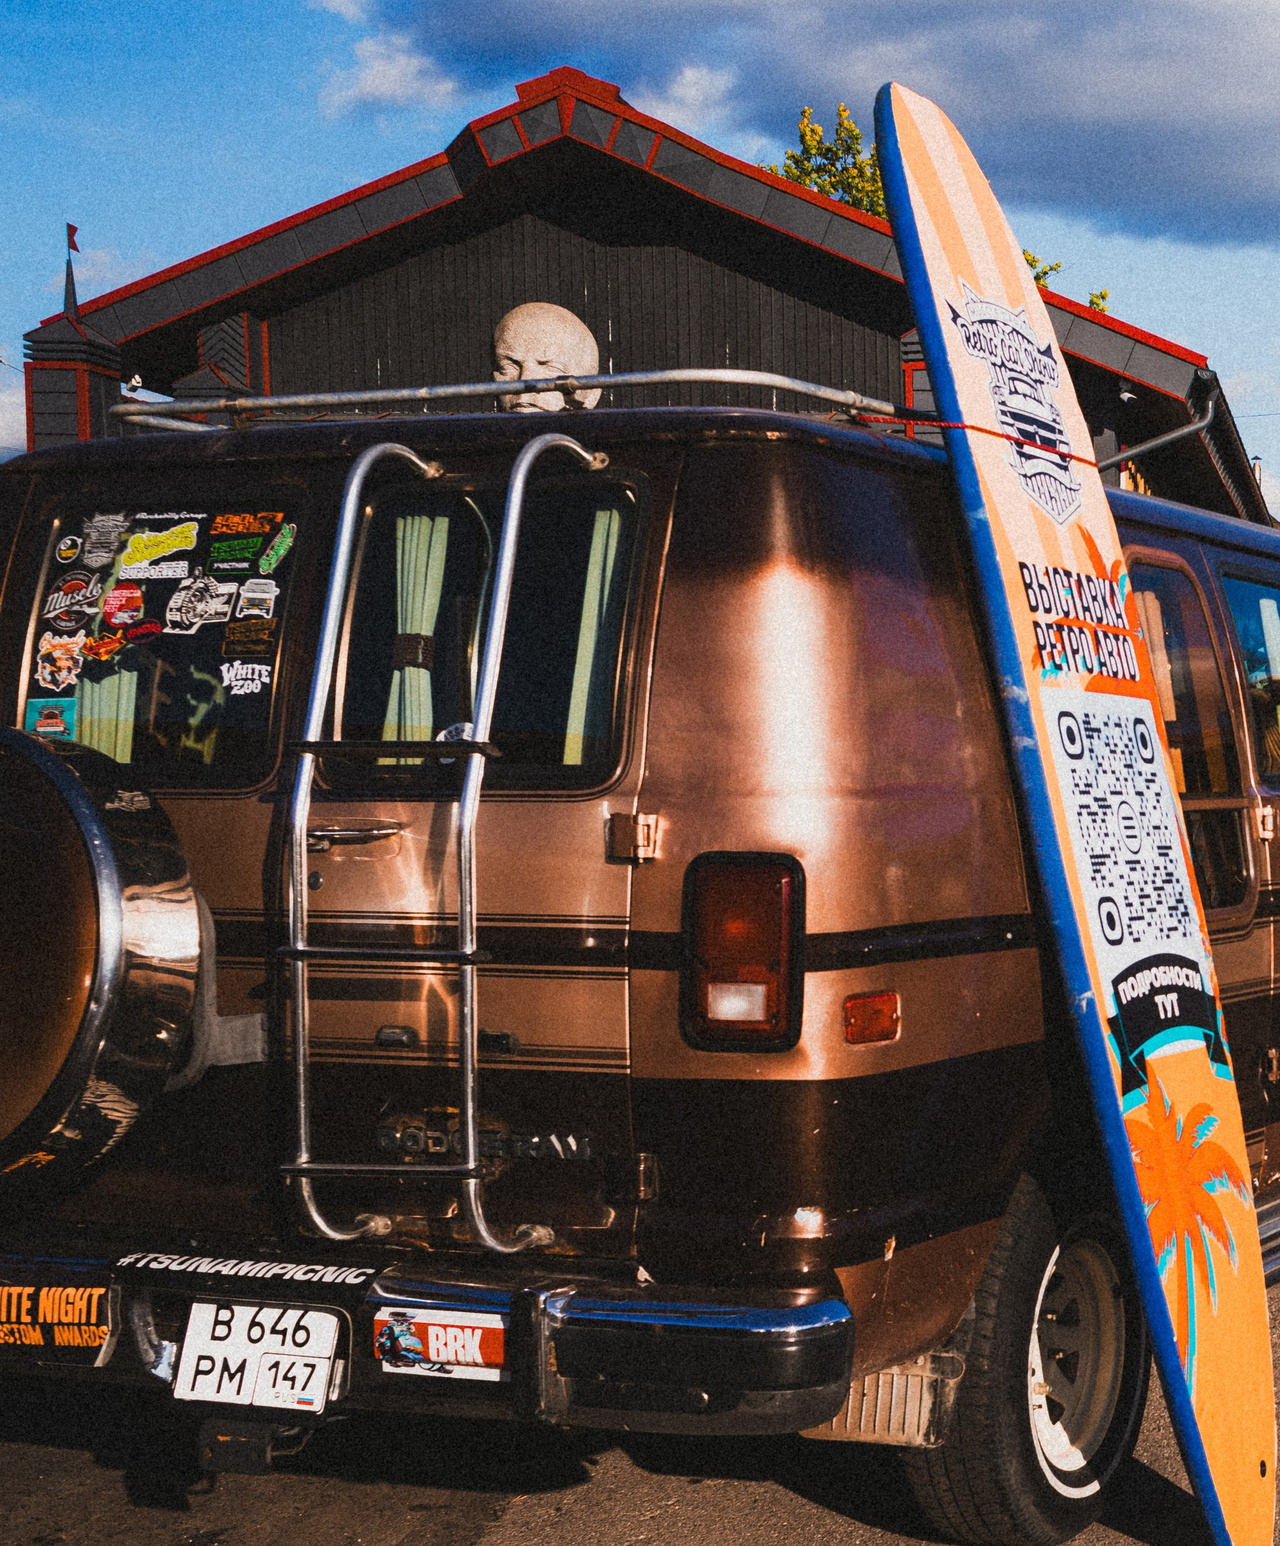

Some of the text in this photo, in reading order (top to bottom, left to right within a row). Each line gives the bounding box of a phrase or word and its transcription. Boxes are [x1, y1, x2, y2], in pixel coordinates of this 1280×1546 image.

[960, 323, 1058, 382] Retro Car Show
[119, 565, 188, 578] SUPPORTER
[1018, 561, 1130, 630] ВЫСТАВКА
[1032, 620, 1140, 682] РЕТРО АВТО
[219, 659, 272, 687] WHITE
[230, 679, 263, 695] ZOO
[1117, 965, 1203, 1005] ПОДРОБНОСТИ
[1154, 992, 1180, 1020] ТУТ
[116, 1252, 376, 1285] #TSUNAMIPICNIC
[0, 1286, 107, 1324] ITE NIGHT
[53, 1325, 109, 1347] AWARDS
[247, 1307, 311, 1348] 646
[427, 1325, 485, 1366] BRK
[267, 1360, 317, 1392] 147
[274, 1391, 297, 1404] RUS
